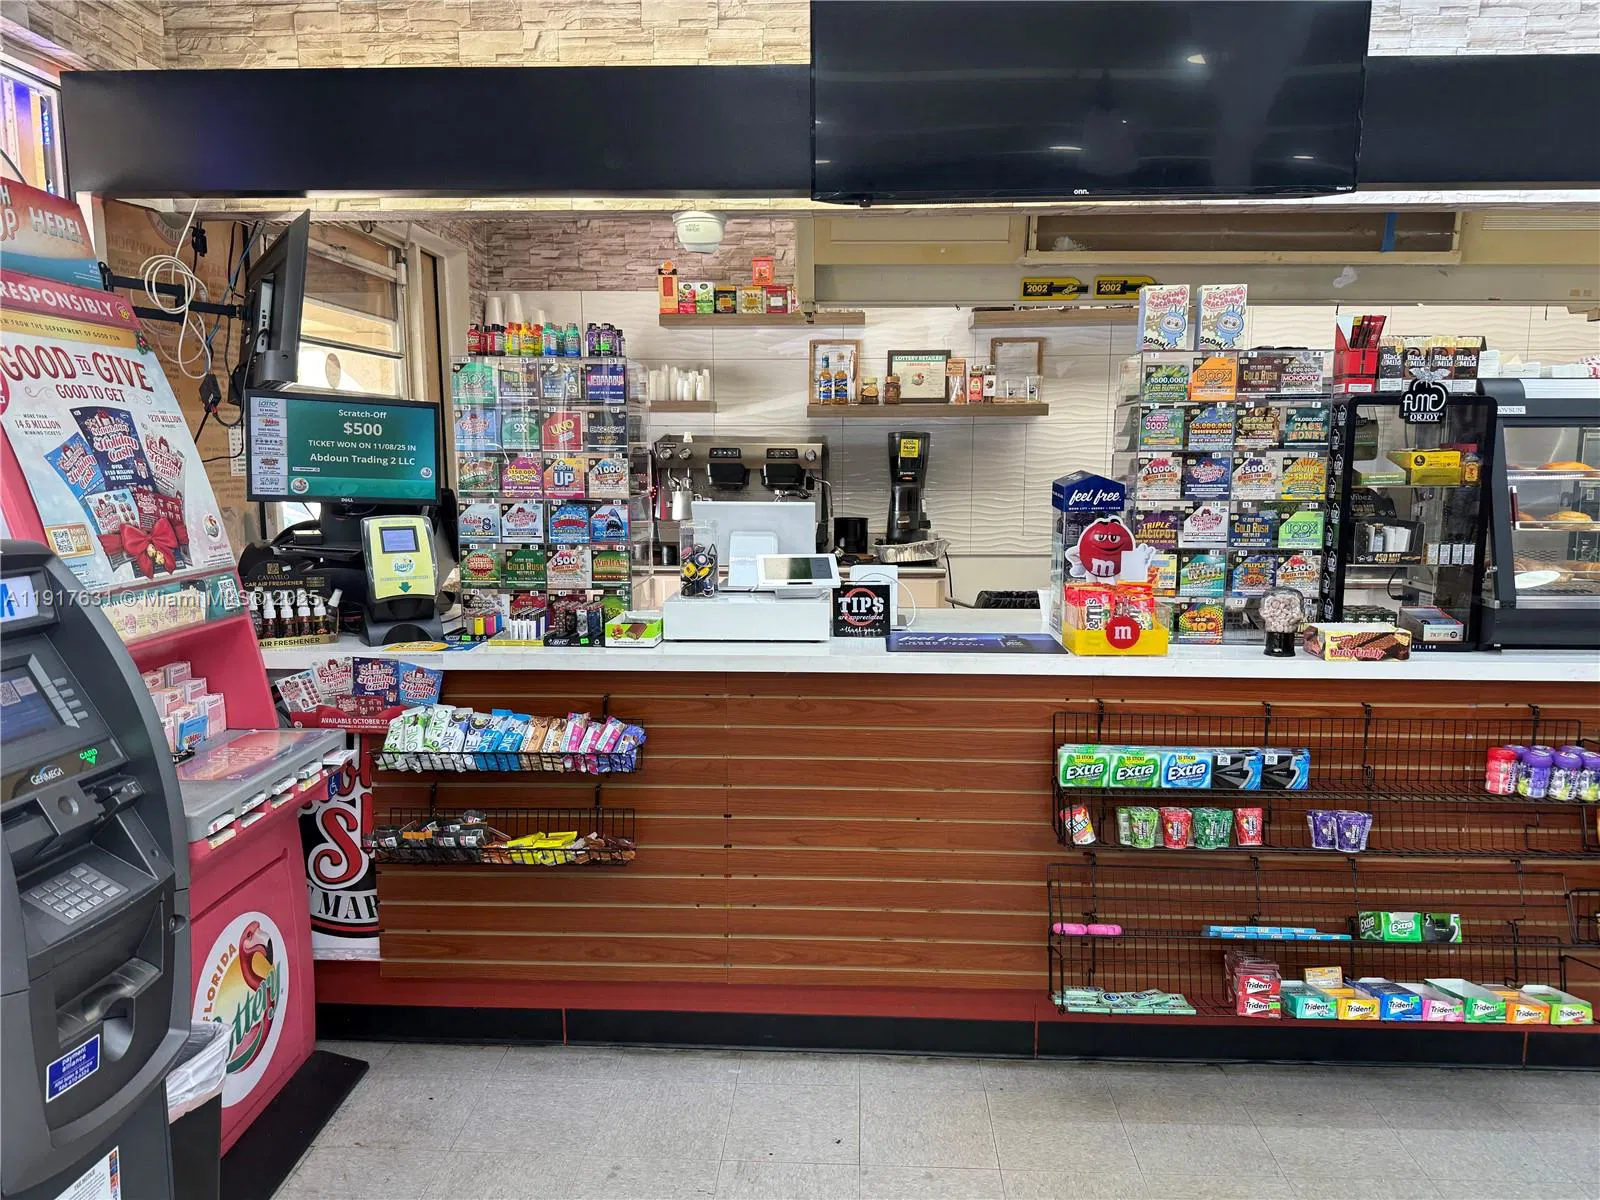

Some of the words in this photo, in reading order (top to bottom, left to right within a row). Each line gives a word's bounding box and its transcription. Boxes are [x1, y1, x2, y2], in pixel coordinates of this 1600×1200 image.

[28, 206, 83, 244] HERE!
[1027, 284, 1048, 292] 2002
[1100, 284, 1121, 292] 2002
[0, 281, 113, 317] RESPONSIBLY
[11, 319, 29, 328] FROM
[31, 322, 42, 330] THE
[46, 325, 83, 336] DEPARTMENT
[93, 332, 108, 340] GOOD
[1, 344, 77, 382] GOOD
[76, 357, 92, 373] TO
[92, 351, 154, 393] GIVE
[460, 372, 485, 385] 50X
[1244, 370, 1260, 380] GOLD
[1261, 370, 1278, 380] RUSH
[55, 384, 88, 400] GOOD
[90, 386, 104, 400] TO
[106, 388, 126, 402] GET
[160, 414, 182, 424] MILLION
[338, 408, 387, 420] Scratch-Off
[15, 419, 36, 429] 14.6
[37, 420, 62, 430] MILLION
[343, 421, 383, 437] $500
[514, 423, 528, 433] 9X
[550, 419, 574, 437] UNO
[1145, 422, 1168, 430] 300X
[93, 435, 140, 452] Holiday
[308, 439, 335, 448] TICKET
[337, 441, 355, 449] WON
[373, 443, 406, 451] 11/08/25
[108, 446, 135, 463] Cash
[310, 452, 349, 463] Abdoun
[351, 455, 388, 466] Trading
[391, 457, 397, 465] 2
[398, 457, 416, 466] LLC
[67, 454, 98, 484] Holiday
[554, 471, 575, 486] UP
[1069, 489, 1094, 506] feel
[1142, 521, 1172, 530] TRIPLE
[1235, 522, 1251, 533] GOLD
[1252, 522, 1269, 533] RUSH
[1135, 529, 1177, 539] JACKPOT
[507, 562, 525, 571] GOLD
[526, 562, 544, 571] RUSH
[1091, 558, 1115, 576] m
[838, 596, 884, 613] TIPS
[849, 613, 884, 622] appreciated
[1114, 625, 1132, 640] m
[259, 640, 272, 648] AIR
[274, 637, 320, 647] FRESHENER
[358, 673, 397, 685] Holiday
[365, 682, 389, 691] Cash
[401, 681, 437, 695] Holiday
[406, 690, 428, 700] Cash
[320, 717, 351, 725] AVAILABLE
[479, 731, 496, 752] ONE
[497, 732, 516, 752] ONE
[79, 748, 98, 760] CARD
[1066, 763, 1104, 779] Extra
[1116, 764, 1154, 780] Extra
[1168, 763, 1206, 780] Extra
[1391, 919, 1414, 932] Extra
[202, 942, 237, 1022] FLORIDA
[1245, 981, 1272, 990] Trident
[1245, 1001, 1271, 1010] Trident
[1304, 1002, 1329, 1011] Trident
[1347, 1005, 1373, 1014] Trident
[1389, 1001, 1413, 1010] Trident
[1431, 1006, 1455, 1014] Trident
[1473, 1003, 1498, 1012] Trident
[1516, 1009, 1542, 1018] Trident
[1559, 1010, 1585, 1018] Trident
[62, 1046, 87, 1066] payment
[62, 1053, 87, 1073] alliance
